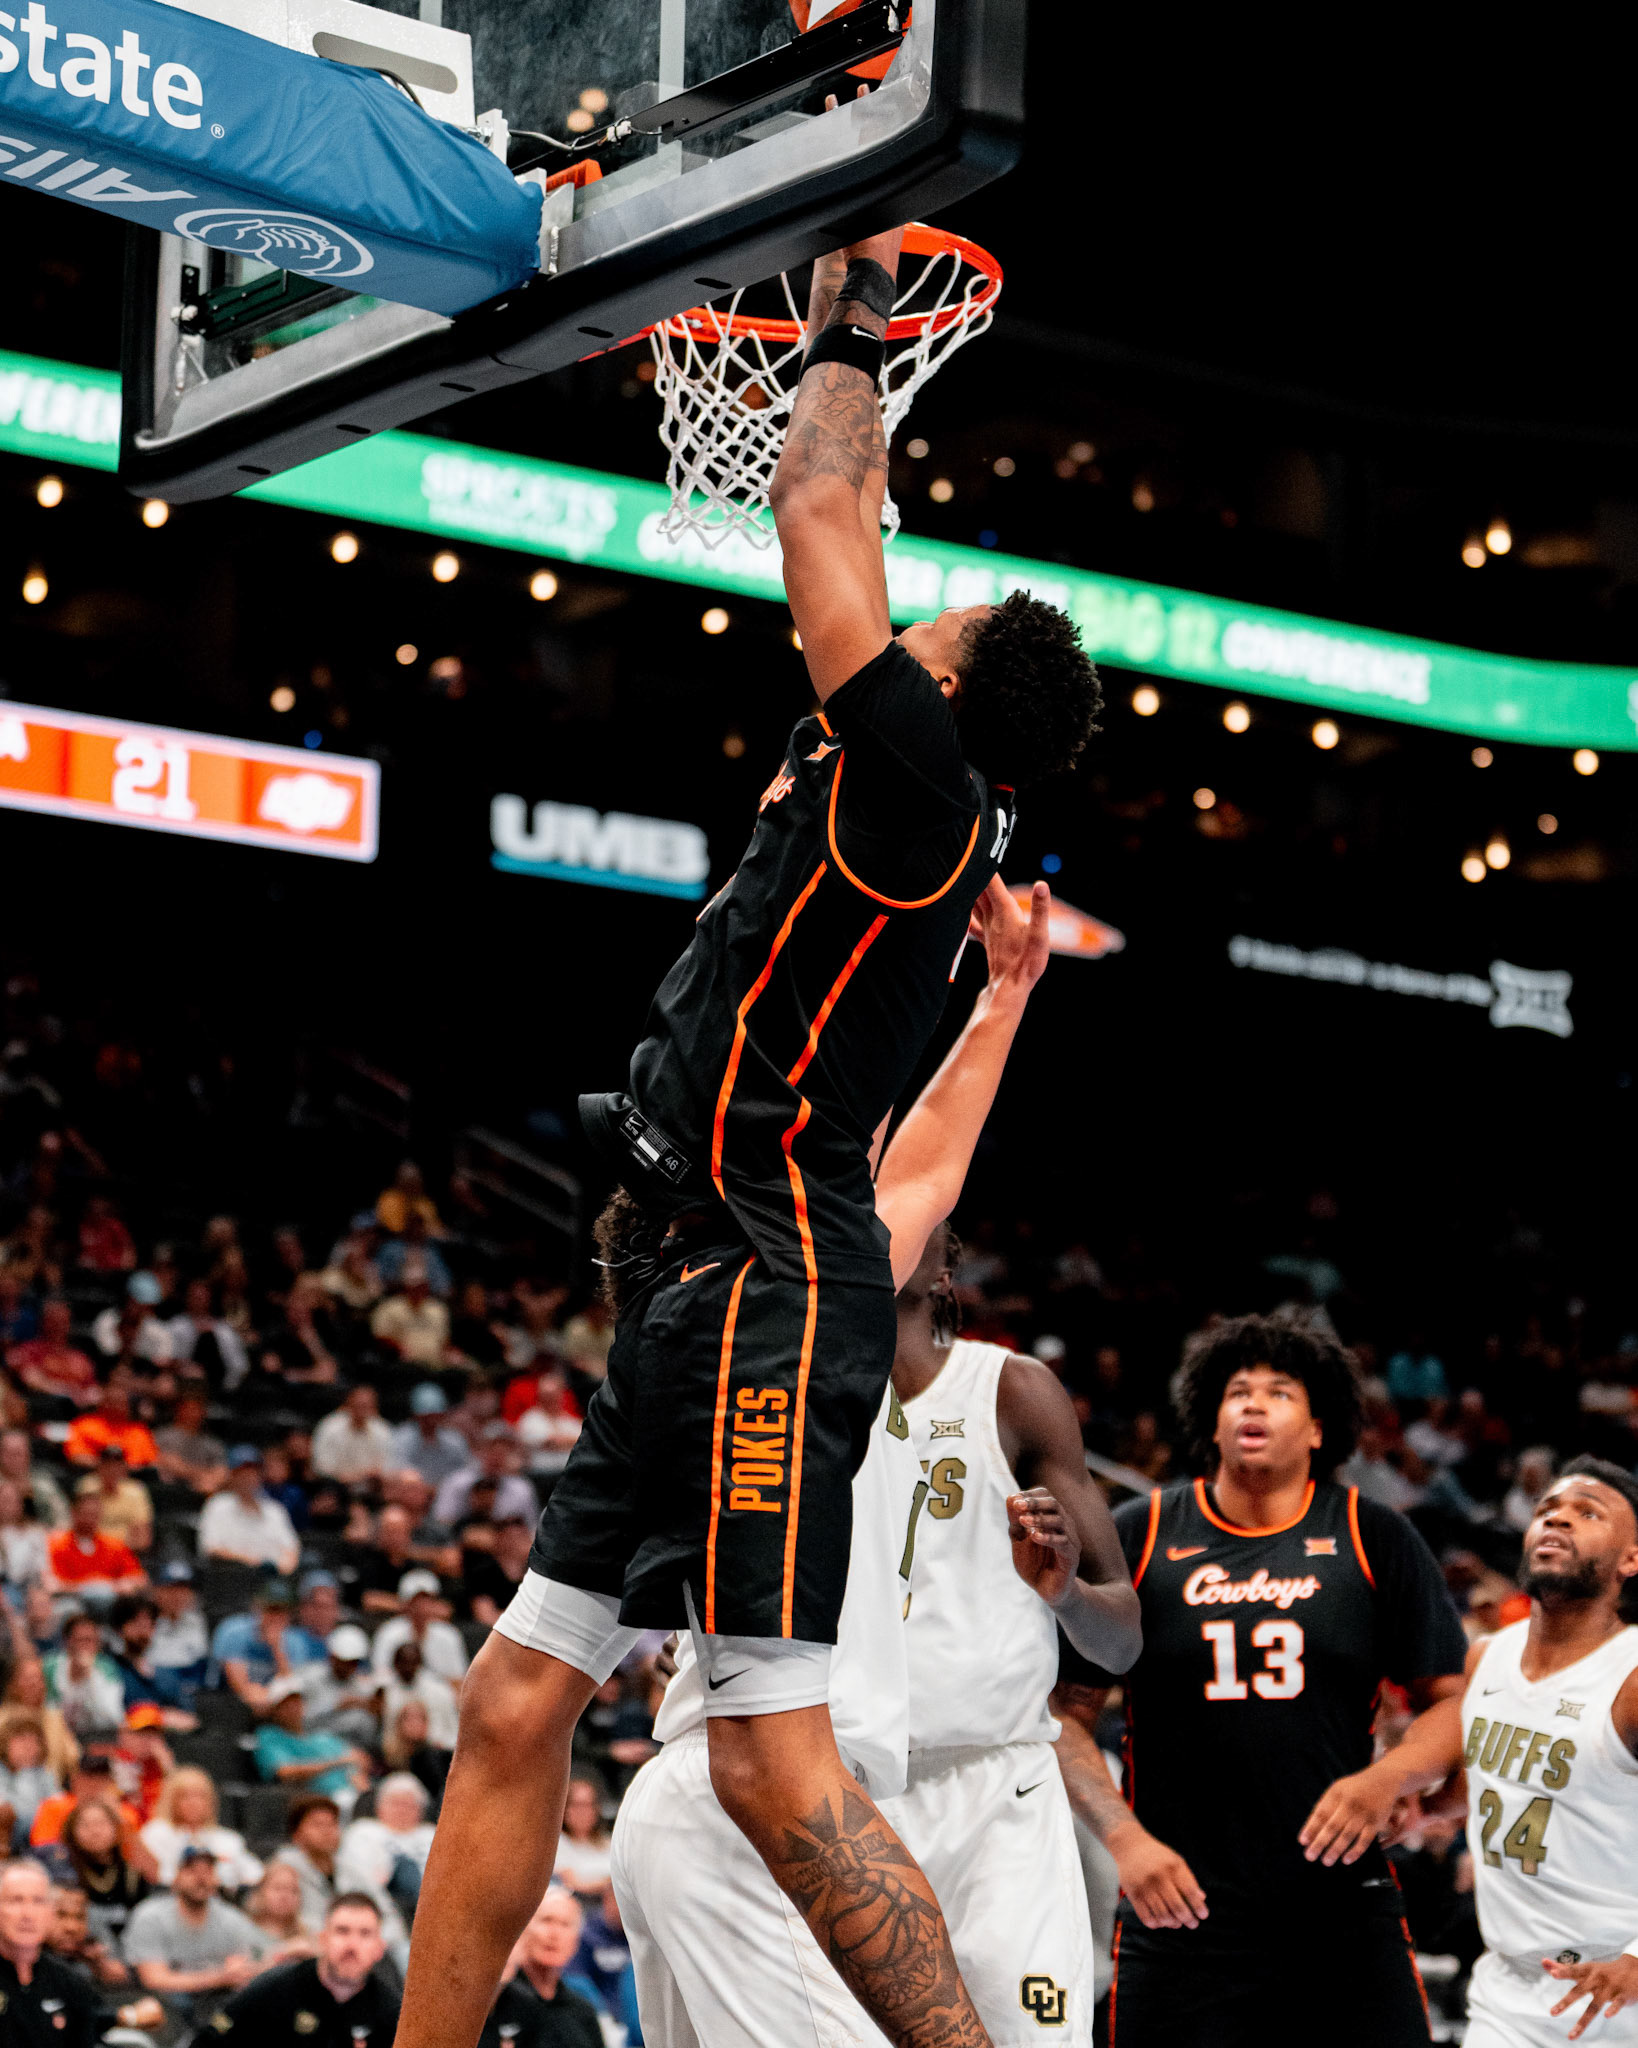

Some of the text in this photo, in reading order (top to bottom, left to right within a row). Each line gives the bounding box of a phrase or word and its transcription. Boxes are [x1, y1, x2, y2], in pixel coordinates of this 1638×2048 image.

[111, 734, 197, 822] 21
[490, 793, 709, 885] UMB
[665, 1156, 679, 1170] 46
[729, 1386, 789, 1513] POKES
[1183, 1563, 1321, 1610] Cowboys
[1202, 1619, 1306, 1701] 13
[1465, 1716, 1577, 1791] BUFFS
[1479, 1789, 1553, 1876] 24
[1019, 1973, 1068, 2028] CU
